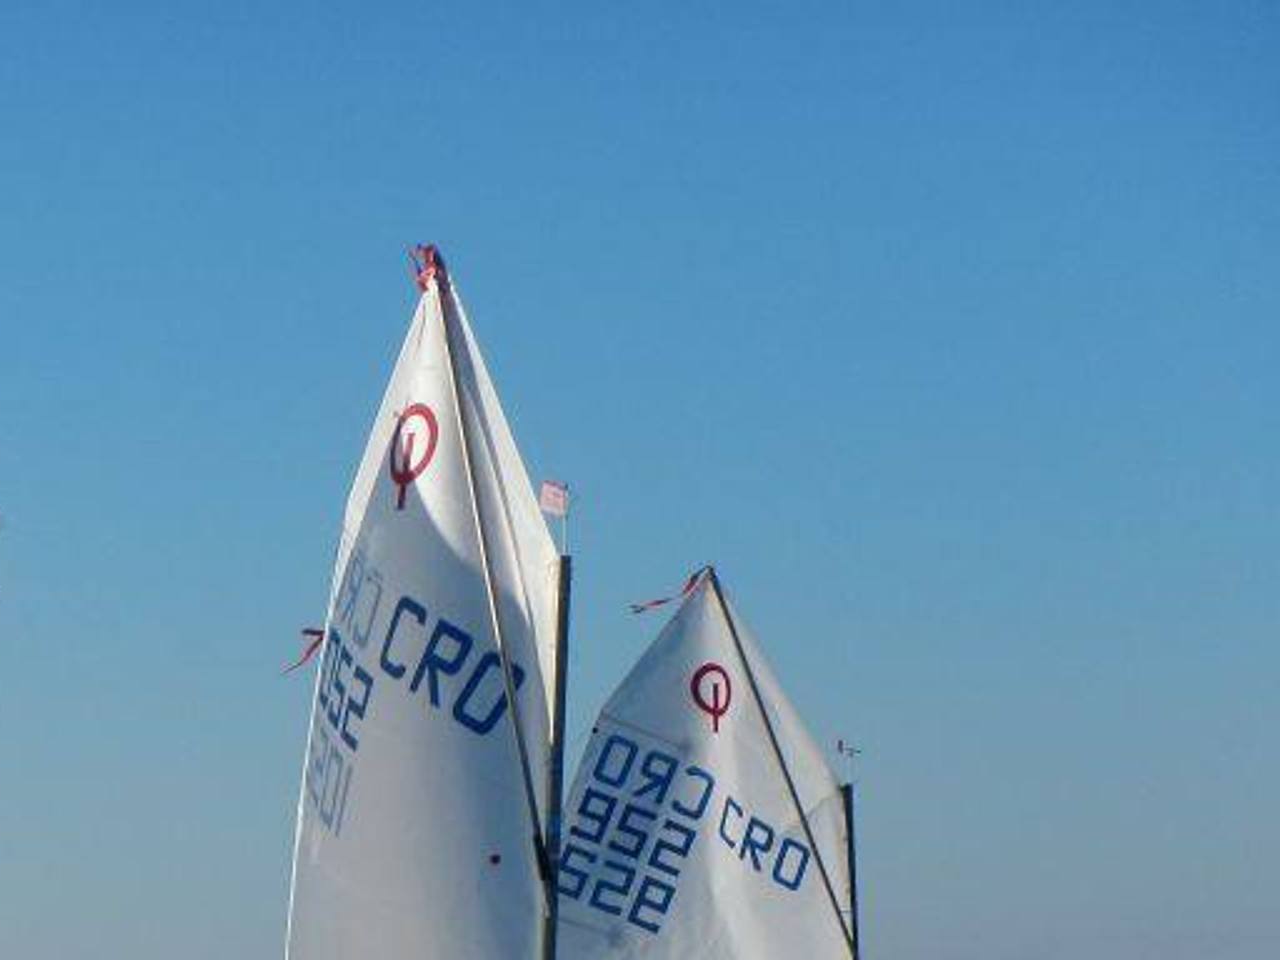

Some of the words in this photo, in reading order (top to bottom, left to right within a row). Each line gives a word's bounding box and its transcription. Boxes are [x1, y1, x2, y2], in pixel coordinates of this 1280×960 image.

[380, 595, 526, 737] CRO
[570, 786, 697, 877] 952
[719, 796, 811, 891] CRO
